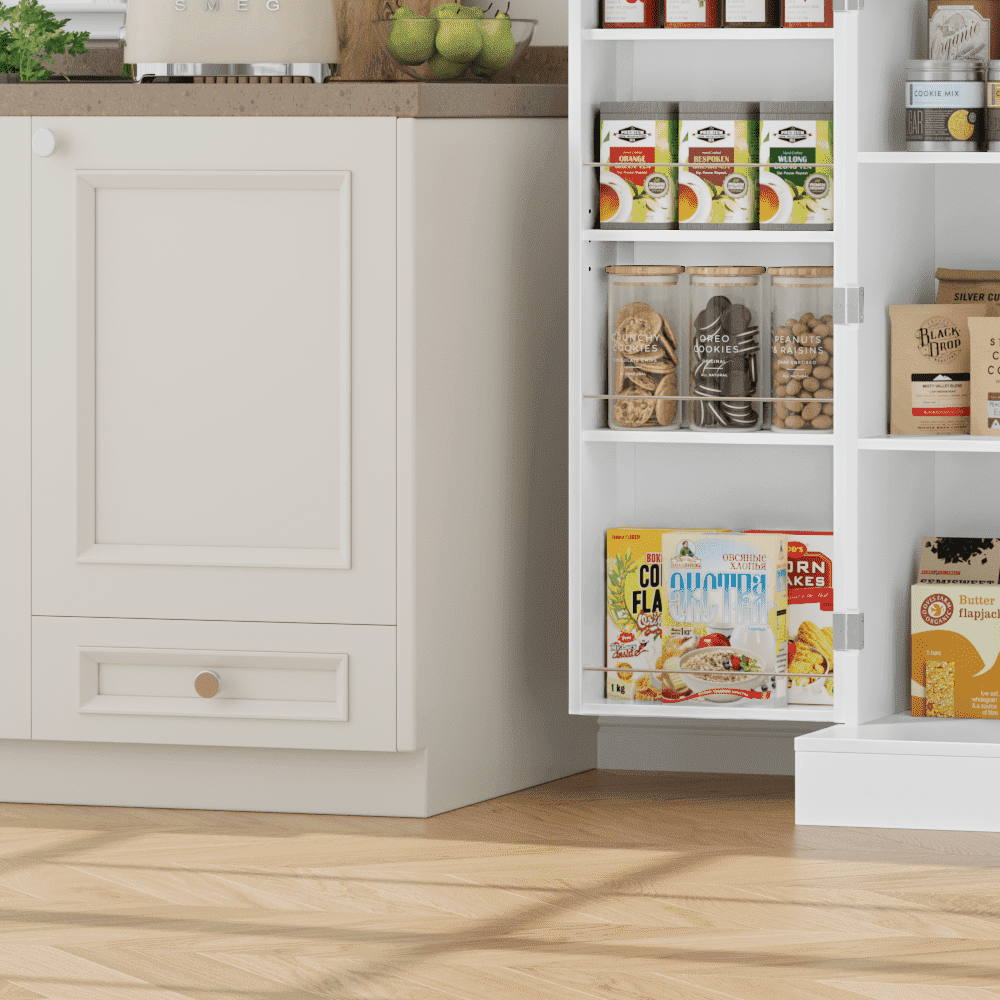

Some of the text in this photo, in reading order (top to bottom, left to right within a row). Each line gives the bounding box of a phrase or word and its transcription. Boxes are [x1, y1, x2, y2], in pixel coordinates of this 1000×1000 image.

[174, 0, 281, 12] SMEG
[618, 155, 646, 163] ORANGE
[693, 155, 730, 164] BESPOKEN
[777, 155, 808, 163] WULONG
[953, 292, 985, 302] SILVER
[611, 333, 661, 342] CRUNCHY
[699, 334, 730, 343] OREO
[774, 335, 822, 344] PEANUTS
[919, 327, 960, 347] BLACK
[613, 344, 658, 353] COOKIES
[693, 345, 739, 354] COOKIES
[780, 346, 824, 355] RAISINS
[929, 338, 961, 357] DROP
[640, 564, 662, 588] CO
[936, 595, 953, 610] FARM
[959, 594, 996, 605] Butter
[922, 595, 936, 615] DOVES
[925, 609, 953, 625] ORGANIC
[616, 683, 626, 694] kg
